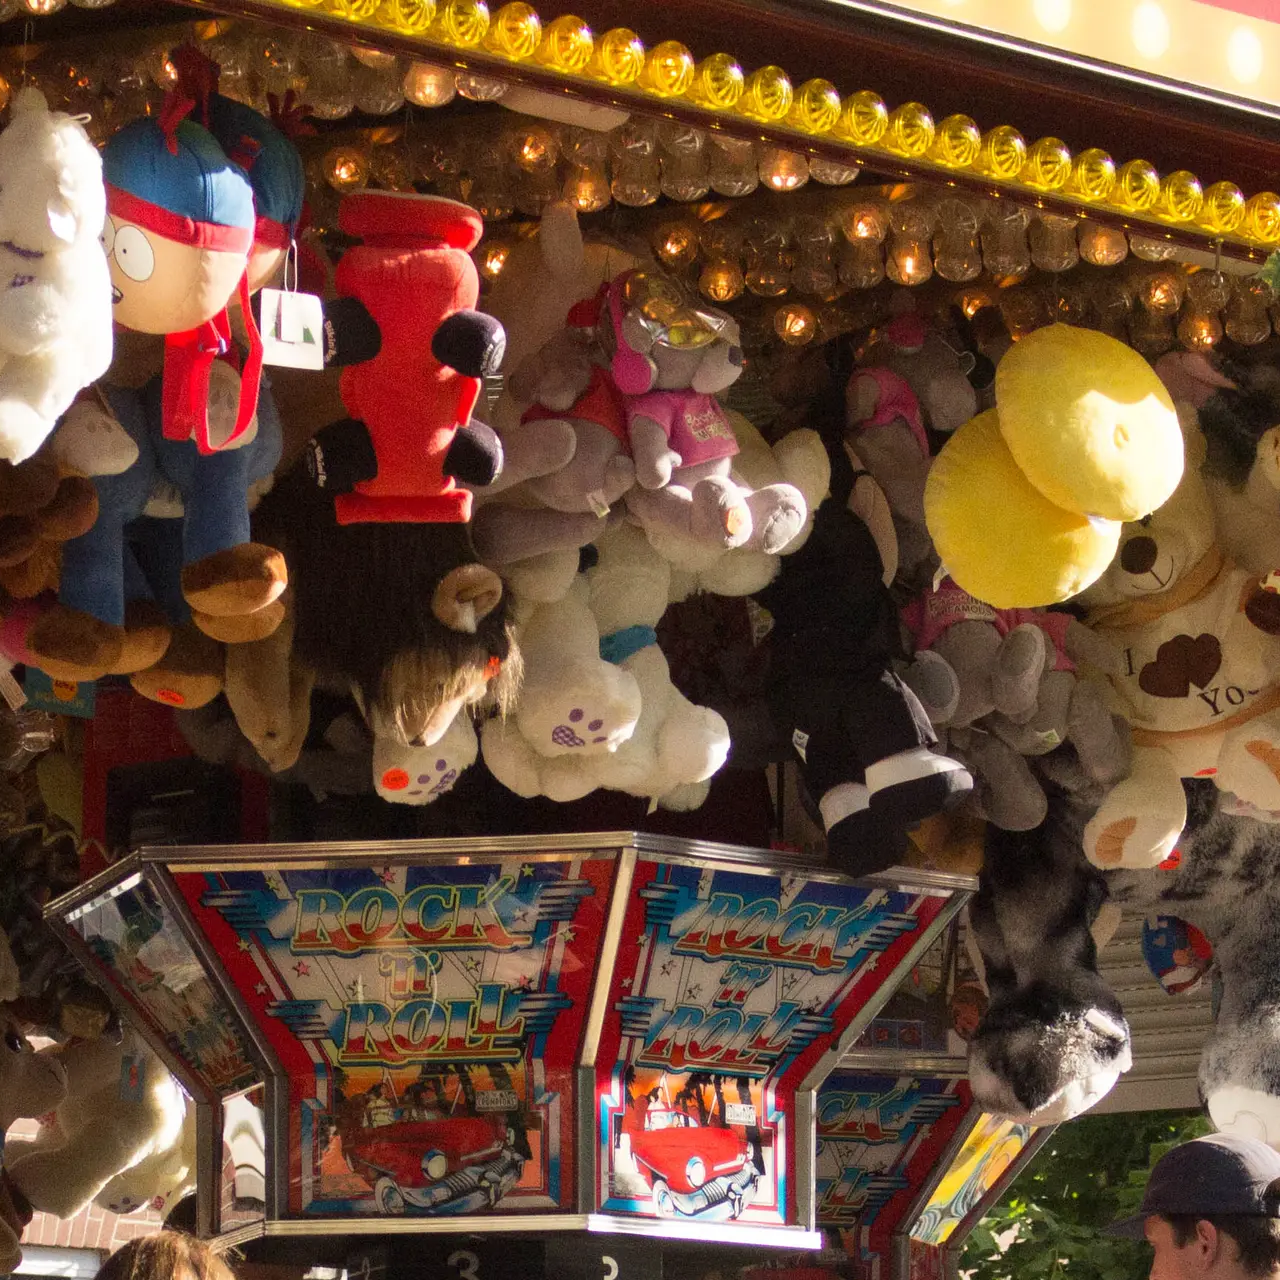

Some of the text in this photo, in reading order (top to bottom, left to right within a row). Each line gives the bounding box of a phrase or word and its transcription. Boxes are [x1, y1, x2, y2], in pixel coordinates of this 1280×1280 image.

[1123, 648, 1136, 677] I
[1197, 685, 1260, 717] YO
[291, 874, 532, 957] ROCK
[672, 892, 876, 975] ROCK
[338, 982, 525, 1068] ROLL
[635, 1000, 803, 1075] ROLL
